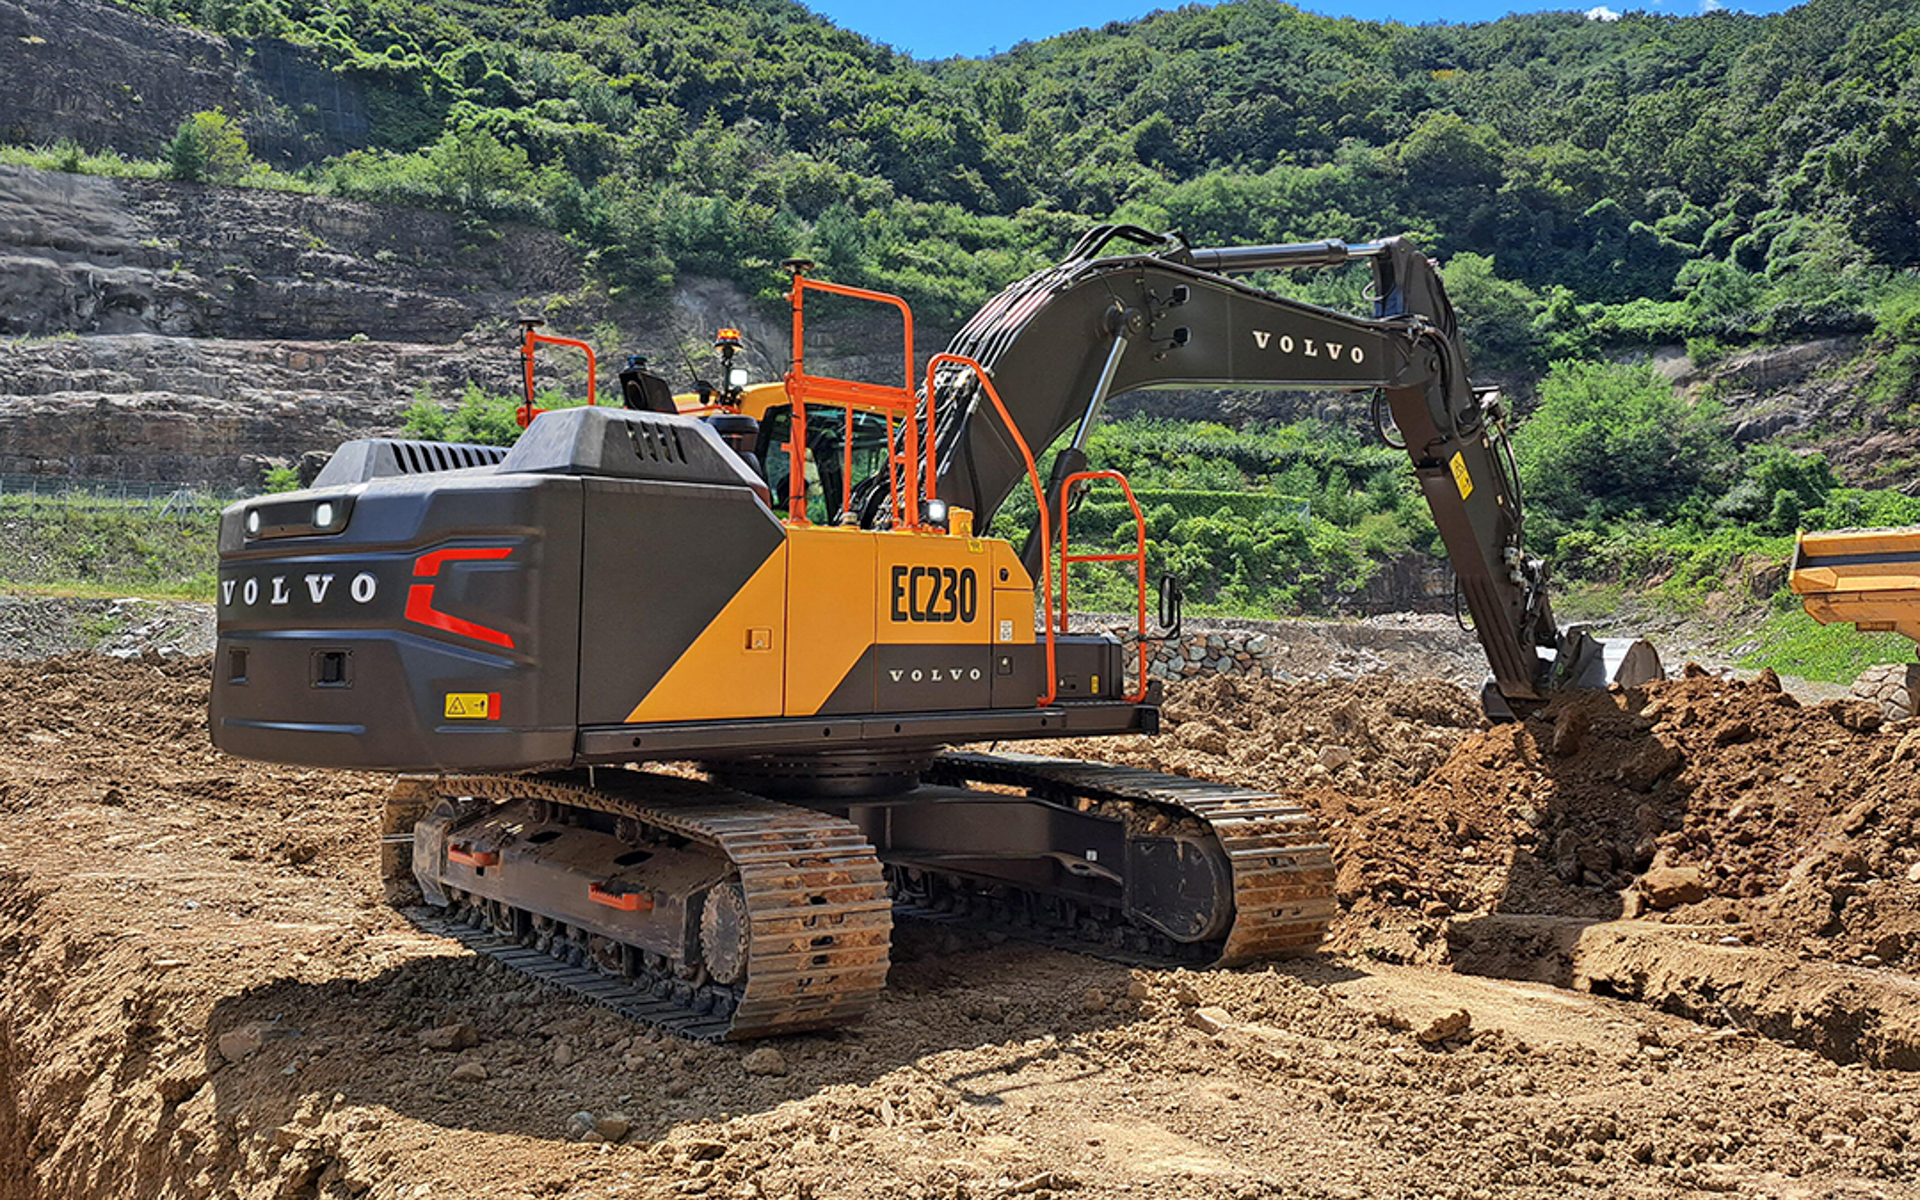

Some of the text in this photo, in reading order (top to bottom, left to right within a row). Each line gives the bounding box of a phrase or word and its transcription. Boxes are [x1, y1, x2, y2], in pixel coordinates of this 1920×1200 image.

[1252, 330, 1364, 364] VOLVO
[222, 573, 376, 605] VOLVO
[892, 567, 977, 623] EC230
[889, 669, 981, 682] VOLVO
